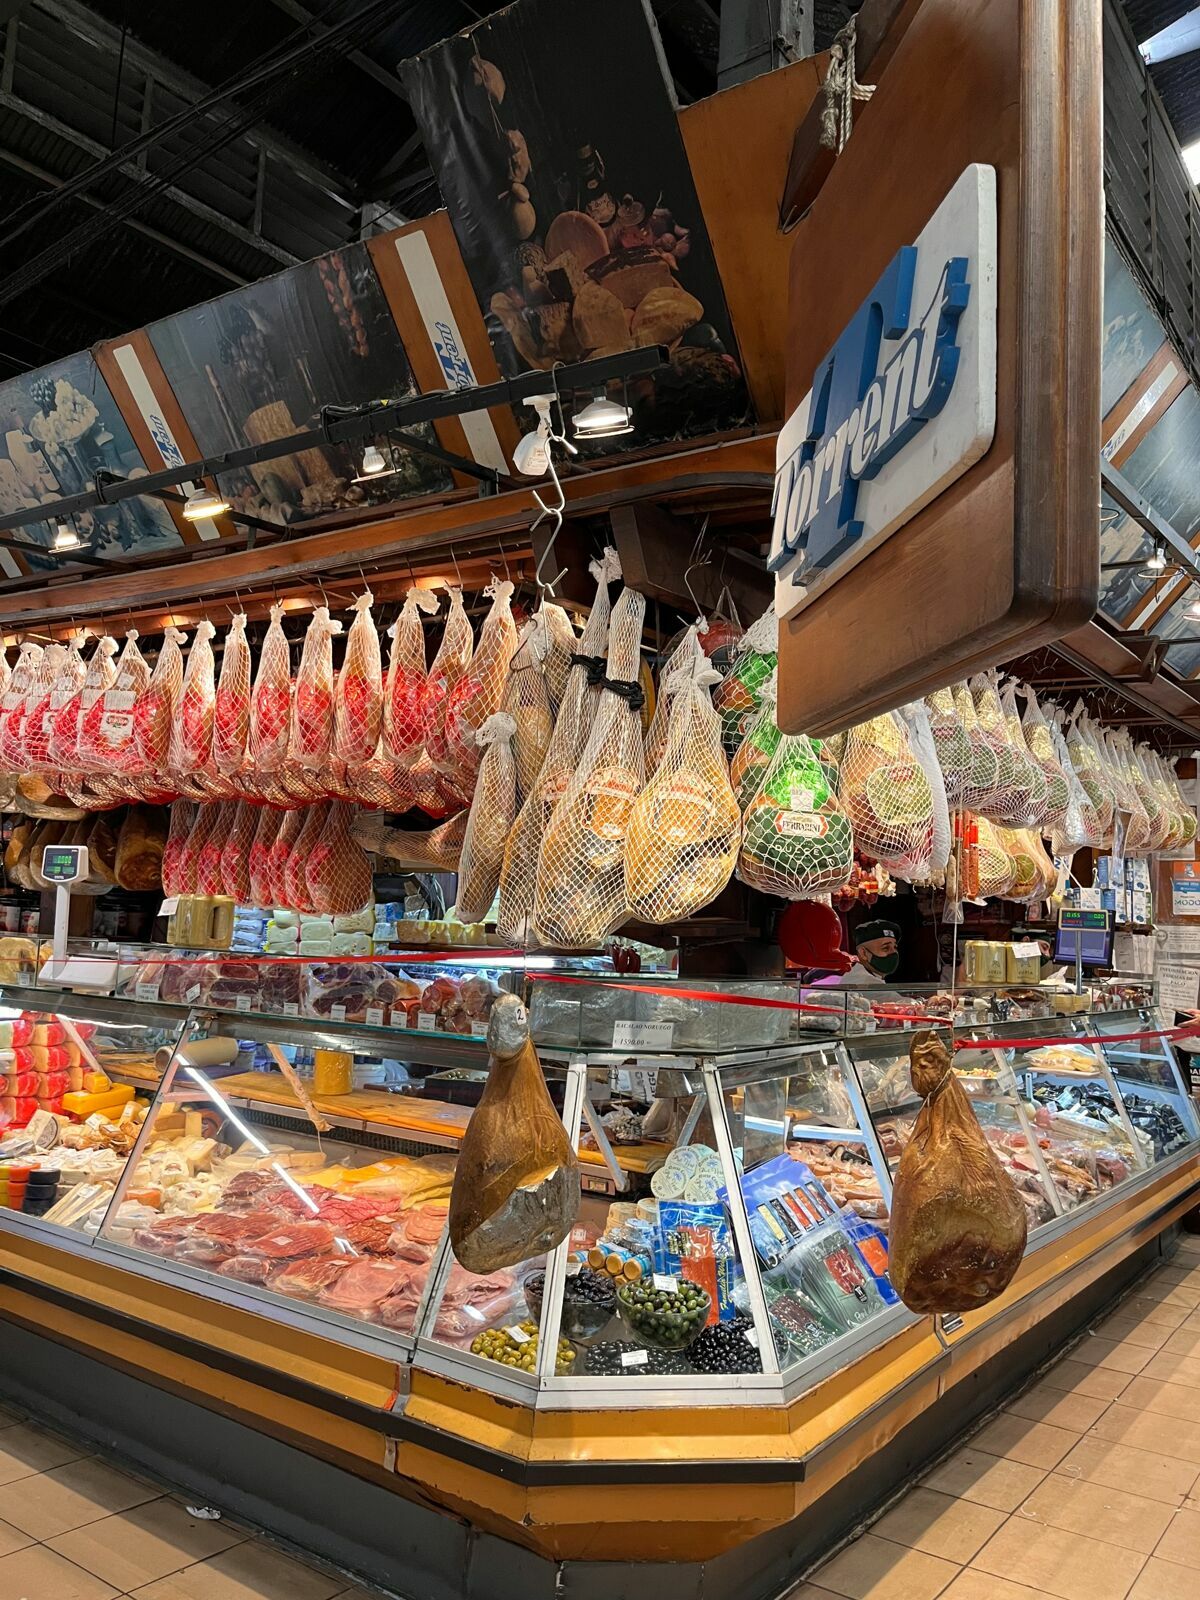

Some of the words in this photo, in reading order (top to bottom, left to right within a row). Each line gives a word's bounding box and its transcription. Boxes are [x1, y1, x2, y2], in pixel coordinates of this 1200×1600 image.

[434, 321, 473, 390] orrent
[150, 414, 184, 468] orrent
[766, 252, 970, 574] Torrent
